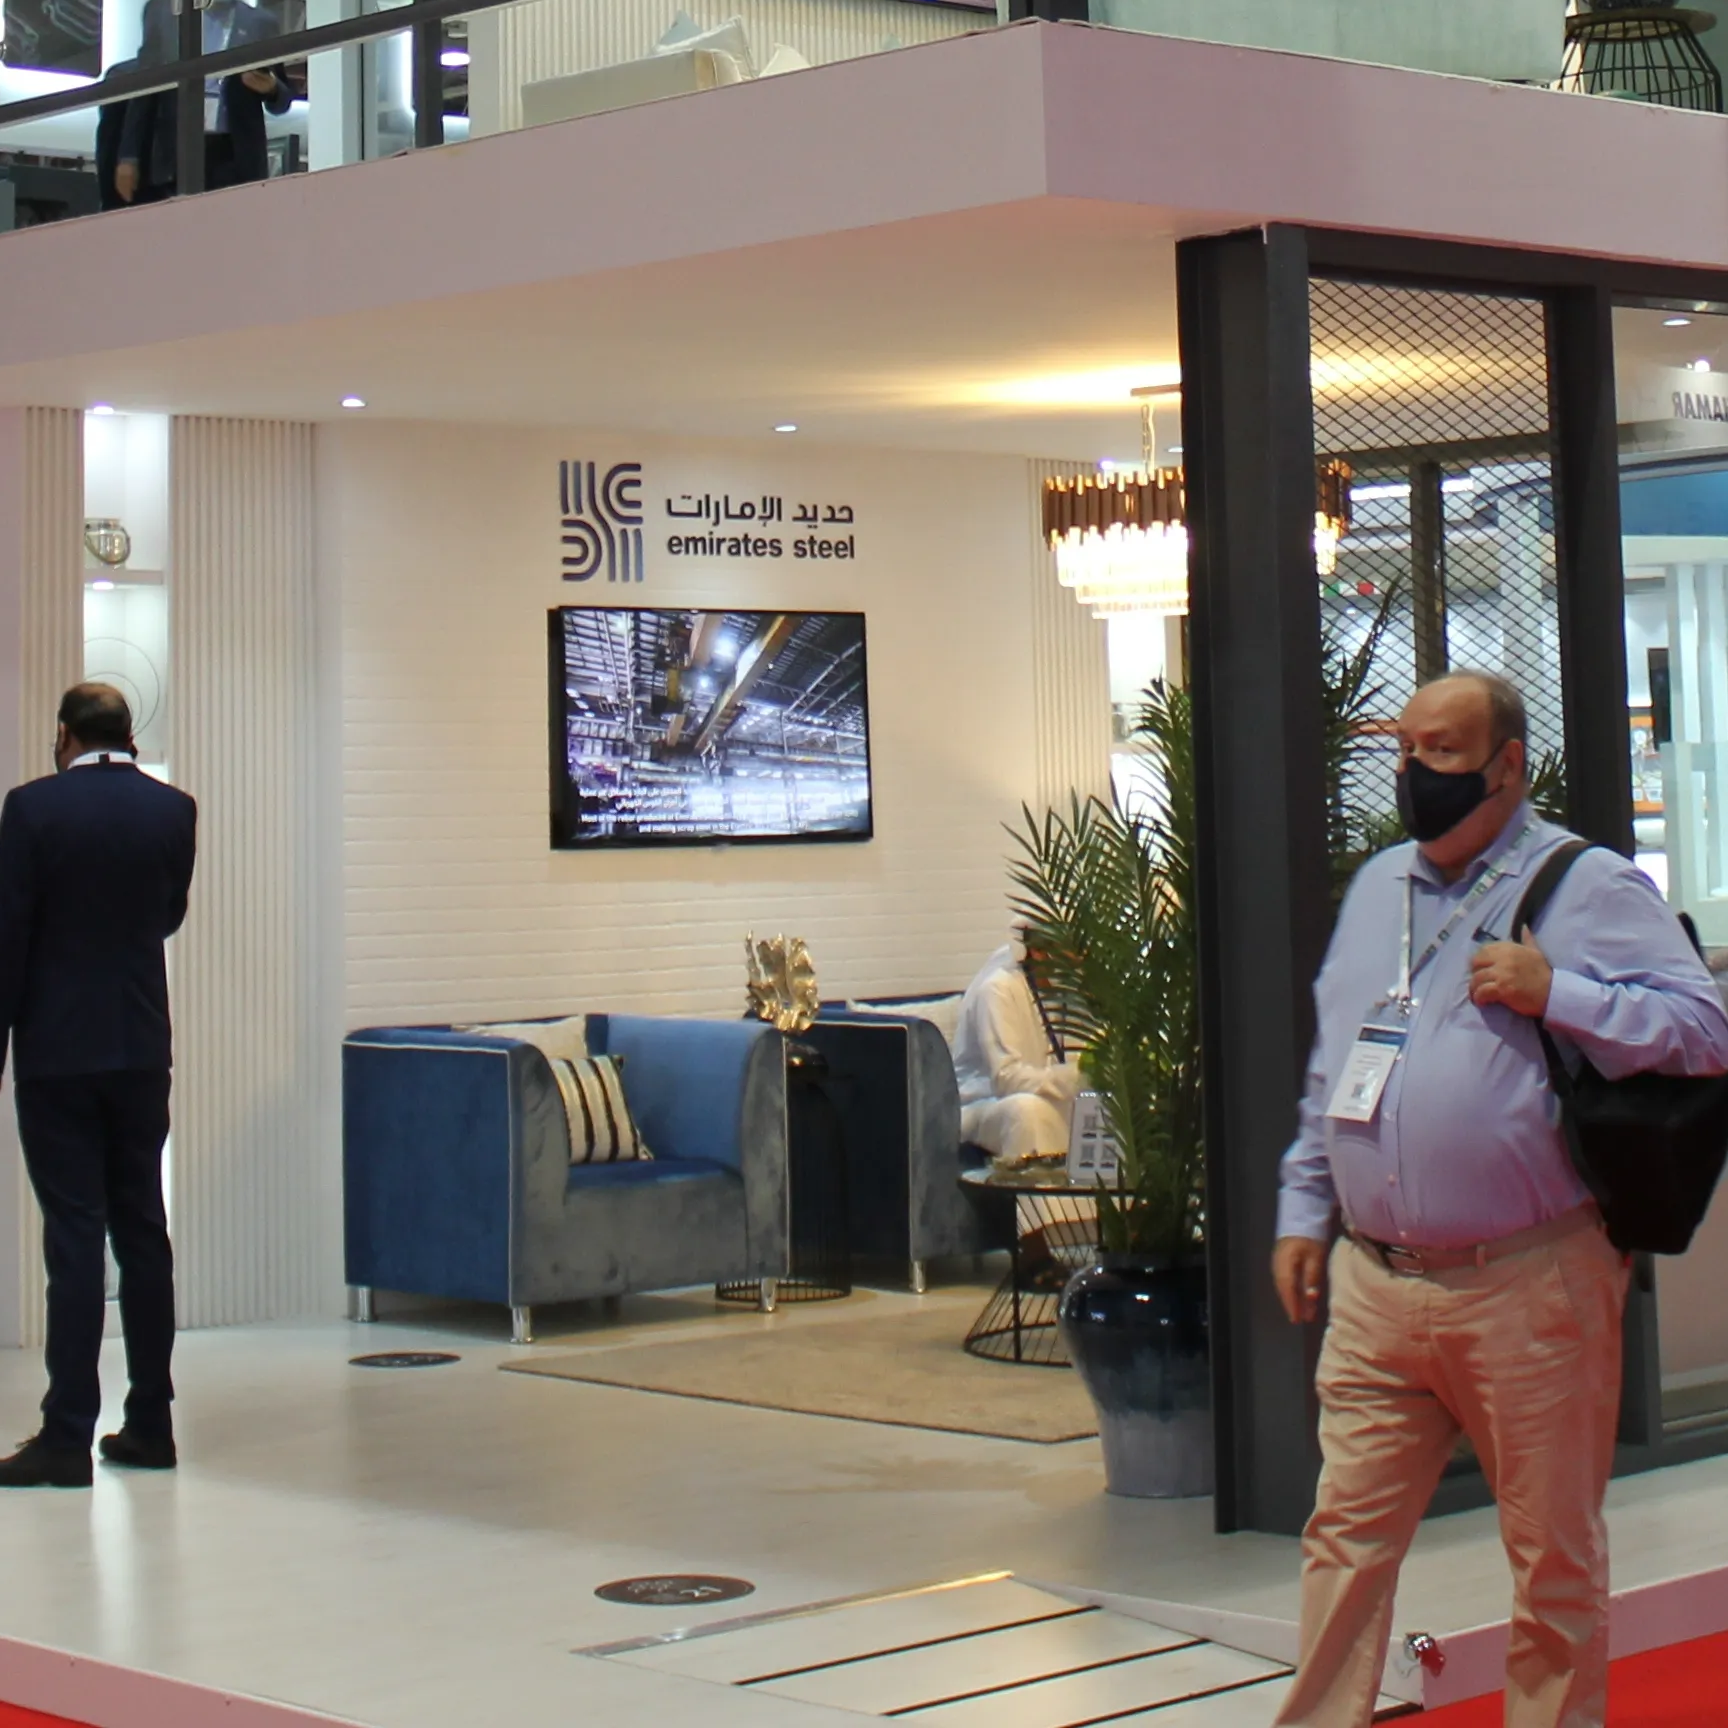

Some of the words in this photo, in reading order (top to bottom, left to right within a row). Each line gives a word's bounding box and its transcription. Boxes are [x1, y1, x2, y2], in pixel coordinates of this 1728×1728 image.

[666, 494, 783, 527] الإمارات
[792, 502, 854, 530] حديد
[667, 531, 784, 559] emirates
[793, 535, 855, 560] steel
